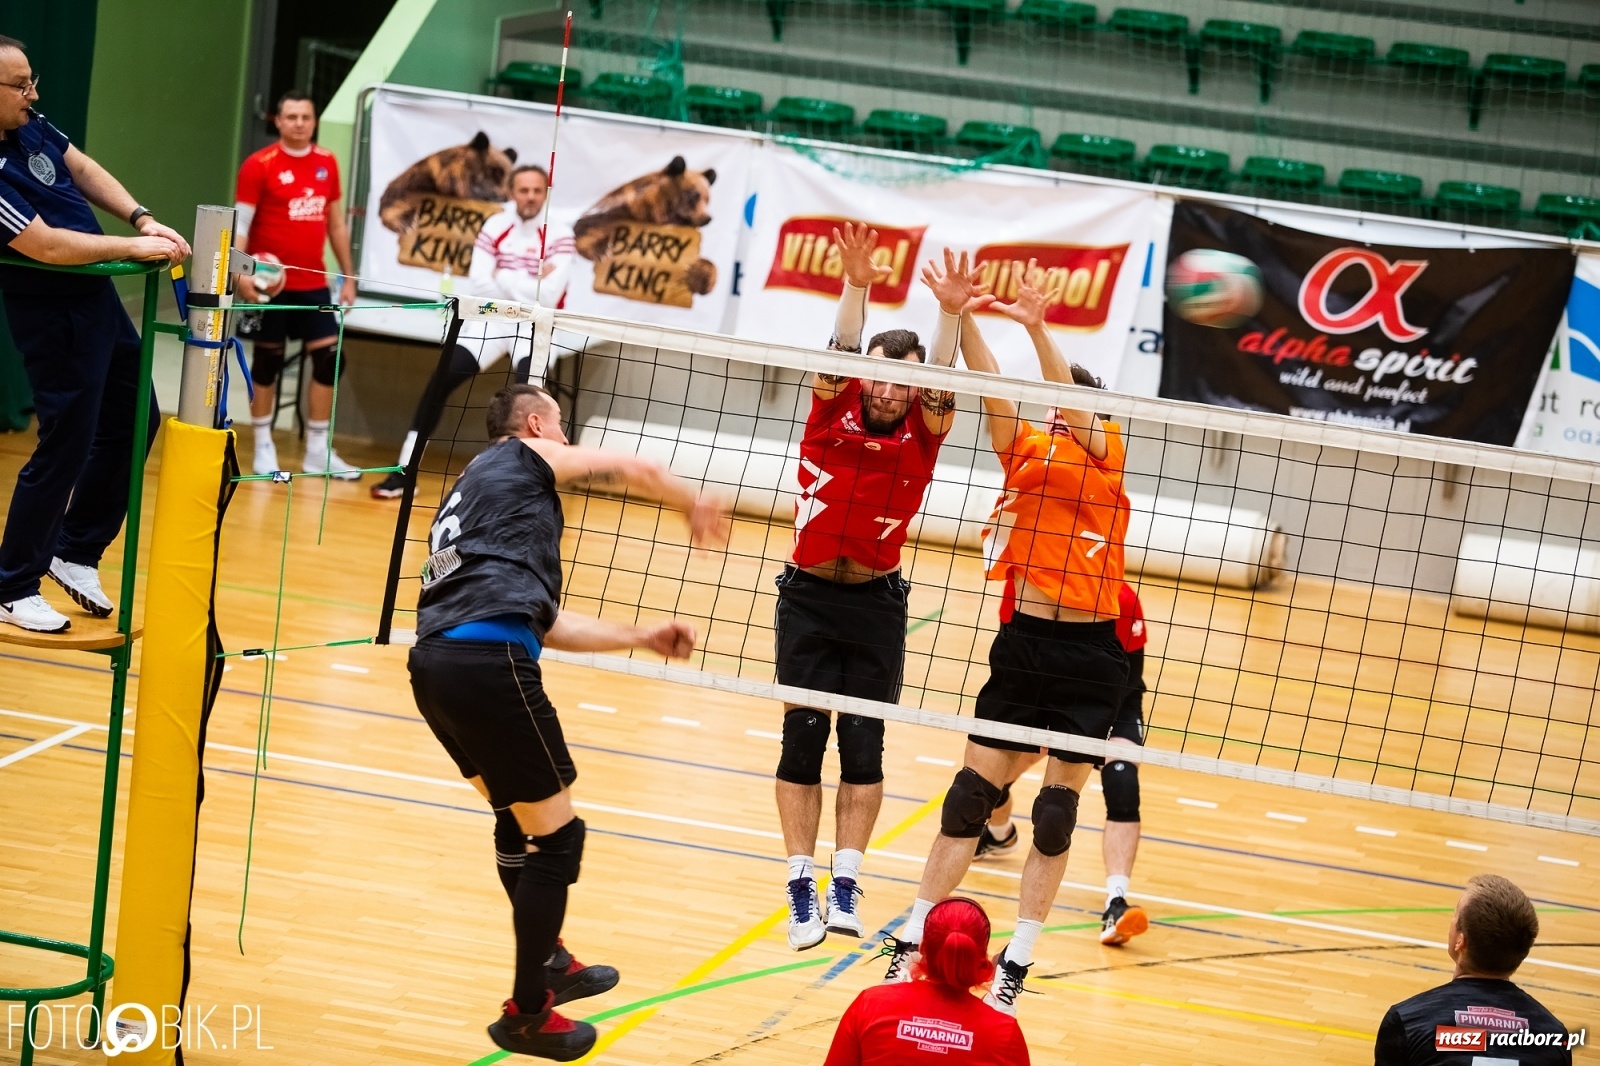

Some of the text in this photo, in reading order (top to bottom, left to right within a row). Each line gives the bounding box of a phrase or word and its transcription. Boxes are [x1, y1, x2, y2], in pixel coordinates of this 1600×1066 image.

[612, 225, 692, 263] BARRY
[605, 261, 671, 303] KING
[1238, 326, 1479, 384] alpha spirit
[1279, 366, 1430, 407] wild and perfect
[873, 516, 904, 540] 7
[1079, 530, 1107, 558] 7
[902, 1024, 967, 1045] PIWIARNIA
[1460, 1014, 1523, 1030] PIWIARNIA
